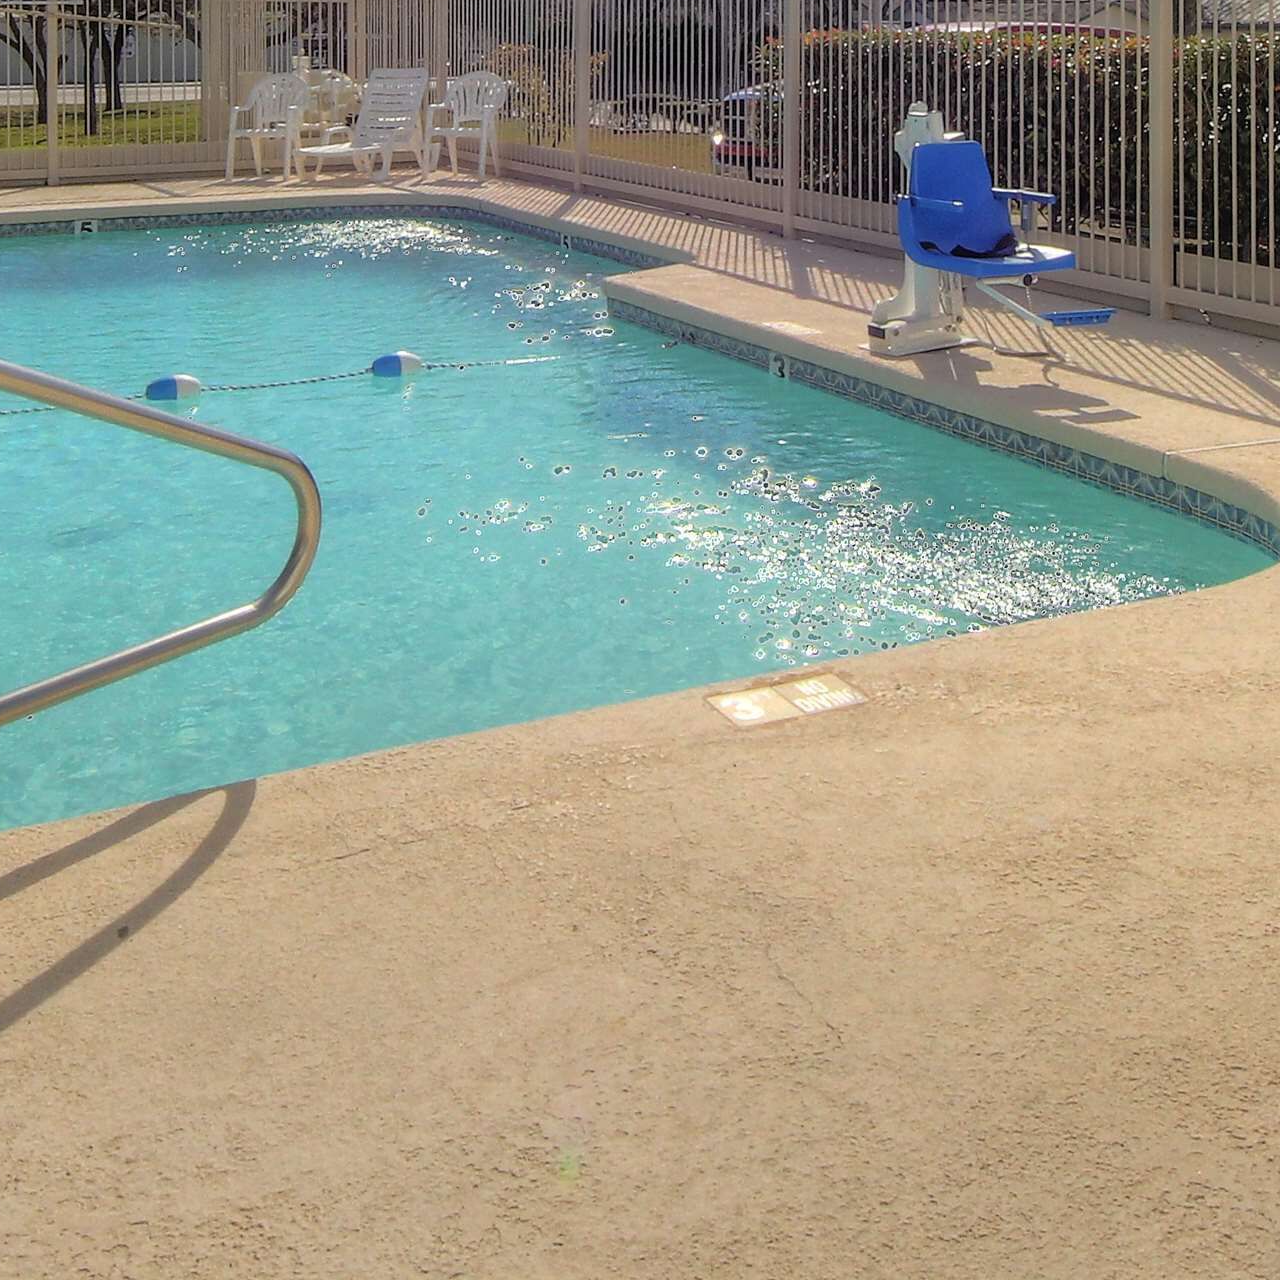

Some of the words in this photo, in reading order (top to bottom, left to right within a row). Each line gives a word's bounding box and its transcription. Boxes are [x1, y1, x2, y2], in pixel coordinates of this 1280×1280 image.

[81, 221, 93, 232] 5
[794, 680, 829, 696] NO
[719, 697, 765, 721] 3
[792, 688, 864, 713] DIVING
